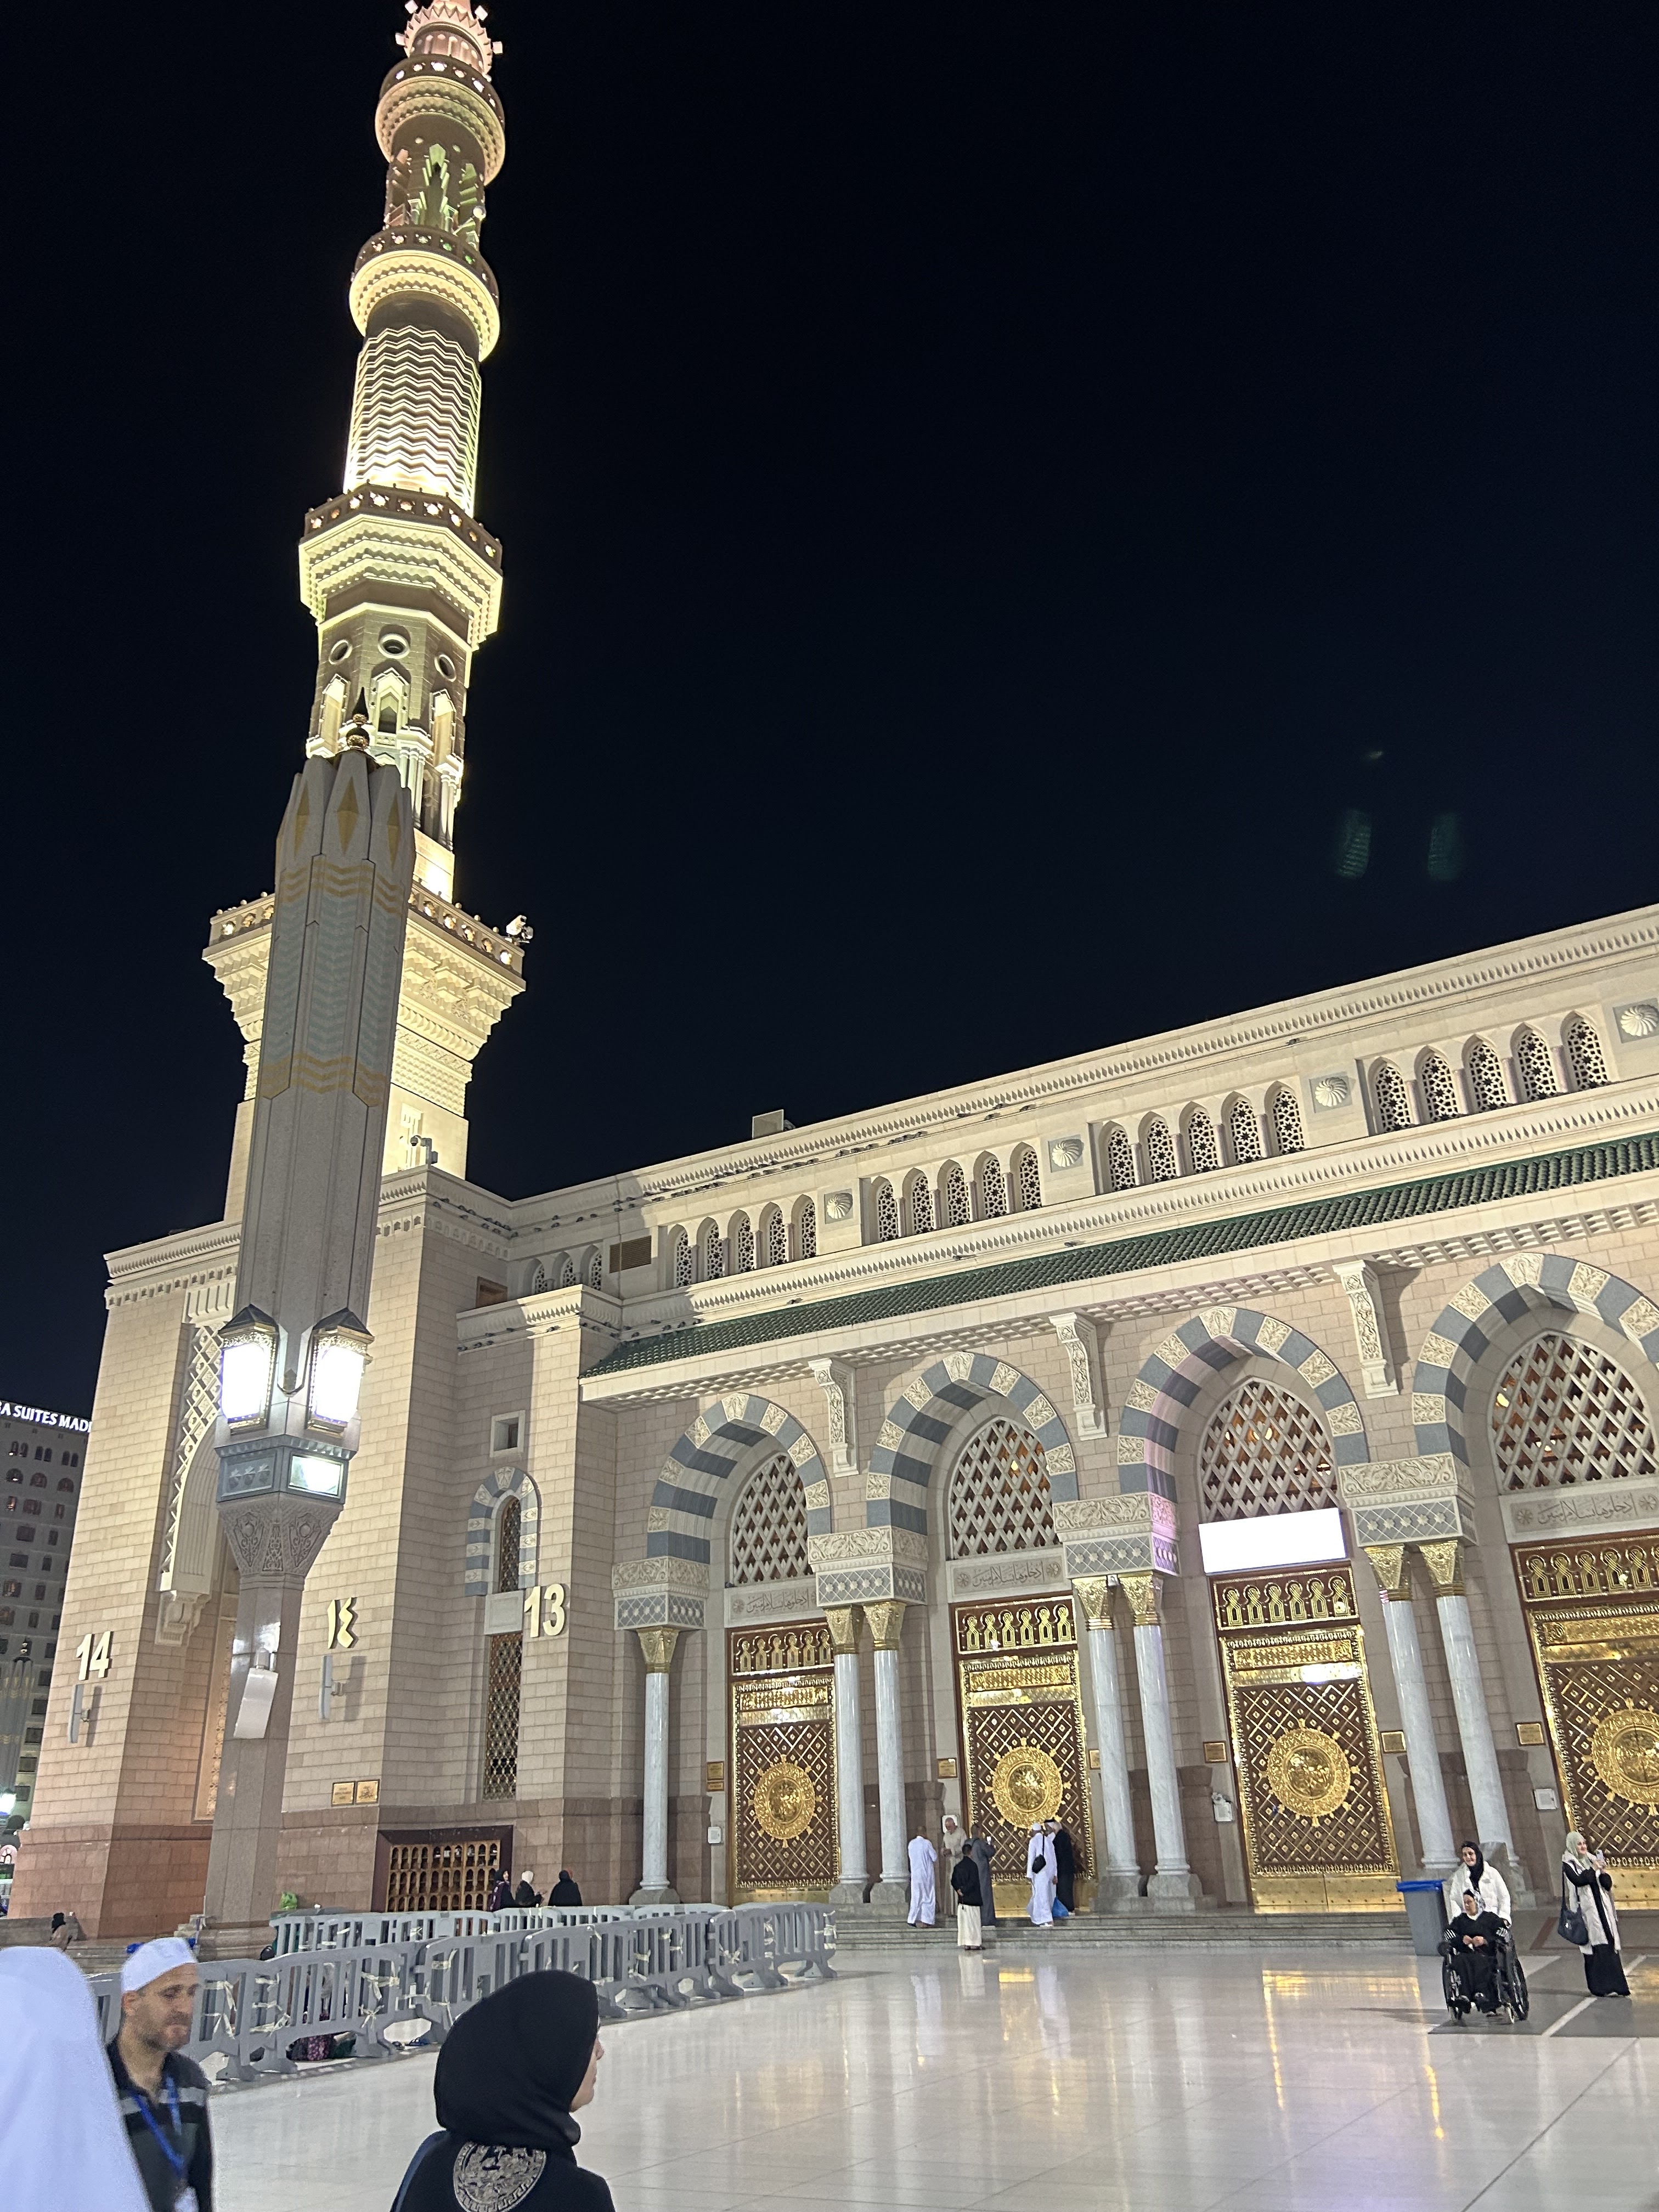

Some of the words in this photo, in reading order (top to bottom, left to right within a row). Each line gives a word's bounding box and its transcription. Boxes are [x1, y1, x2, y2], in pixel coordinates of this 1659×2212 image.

[13, 1405, 58, 1425] SUITES
[327, 1597, 354, 1649] ١٤
[523, 1583, 565, 1638] 13
[76, 1630, 111, 1681] 14
